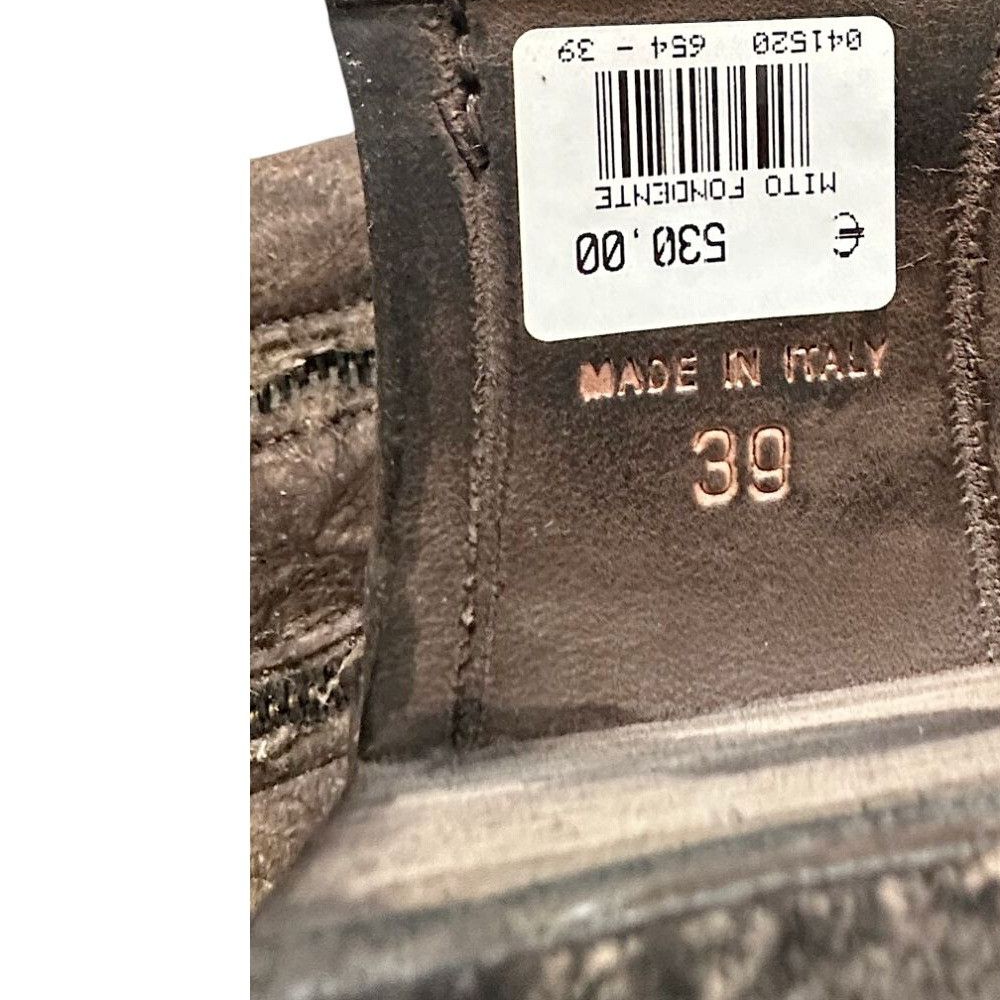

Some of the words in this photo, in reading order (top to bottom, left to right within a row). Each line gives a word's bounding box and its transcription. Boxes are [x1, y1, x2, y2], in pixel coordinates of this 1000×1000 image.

[557, 38, 595, 62] 39
[650, 34, 706, 59] 654
[752, 28, 862, 54] 041520
[594, 177, 745, 210] FONDENTE
[764, 171, 837, 198] MITO
[575, 221, 726, 275] 530,00
[832, 211, 865, 258] €
[579, 354, 699, 402] MADE
[722, 347, 762, 390] IN
[782, 337, 890, 384] ITALY
[691, 424, 792, 508] 39
